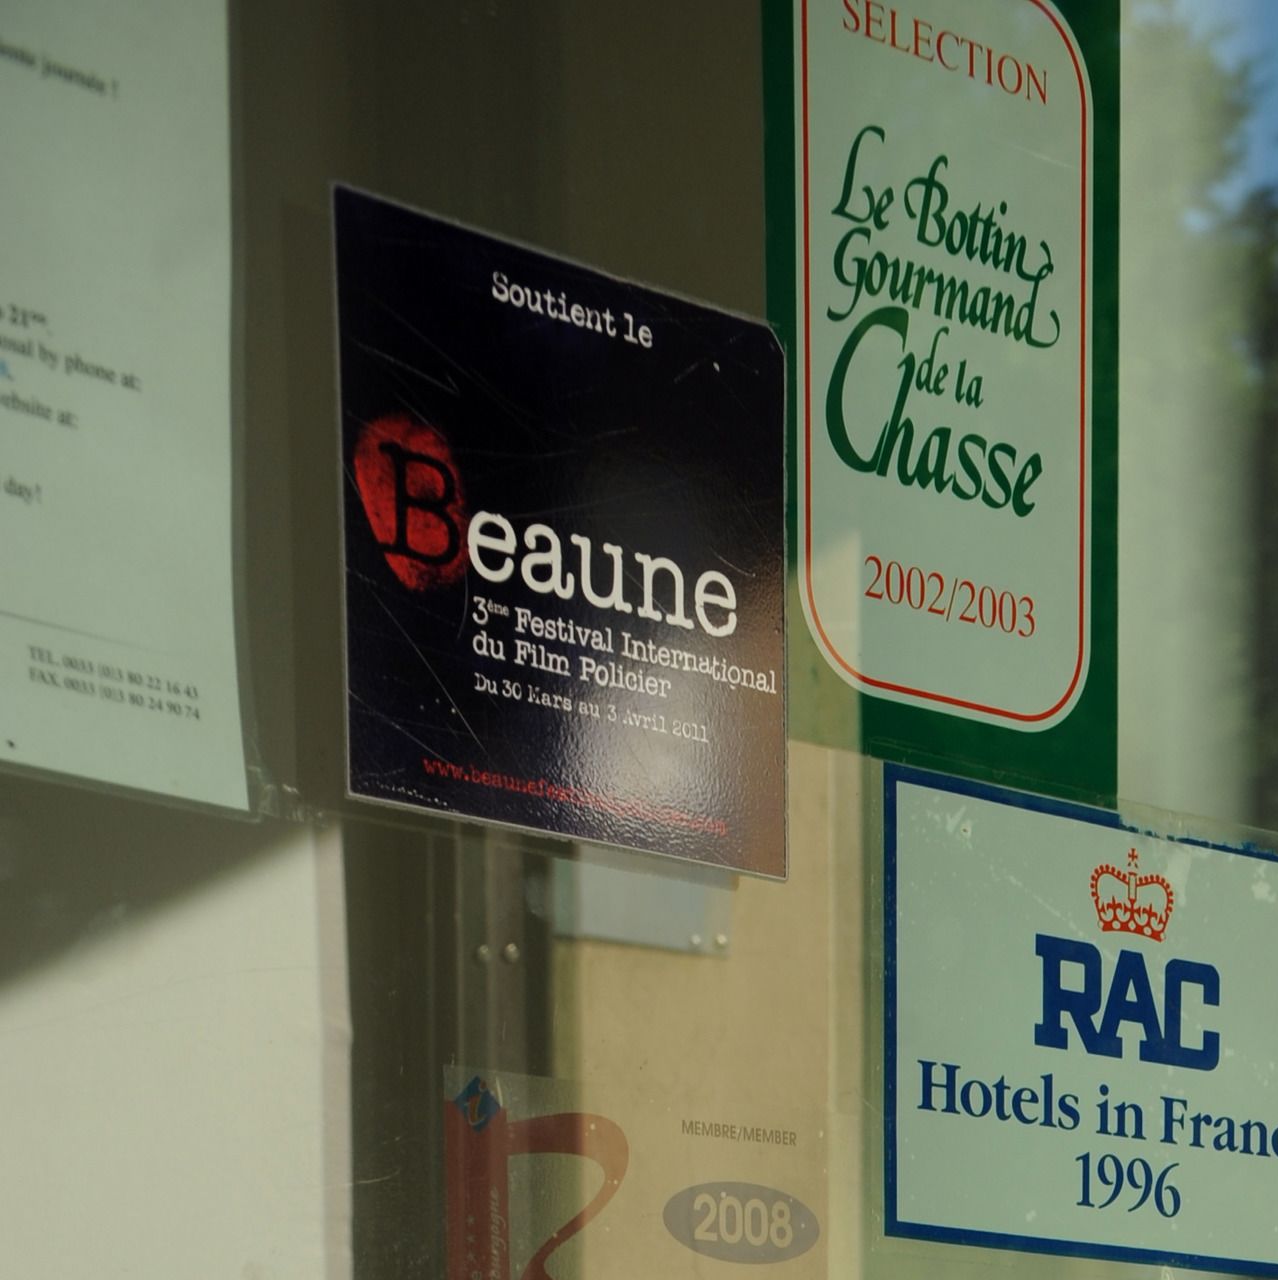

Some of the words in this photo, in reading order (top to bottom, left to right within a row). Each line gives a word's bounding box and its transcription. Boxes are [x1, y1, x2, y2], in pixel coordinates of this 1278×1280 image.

[842, 0, 1047, 105] SELECTION
[831, 125, 894, 231] Le
[903, 155, 1054, 282] Bottin
[491, 270, 618, 336] Soutient
[622, 312, 653, 348] le
[826, 227, 1060, 349] Gourmand
[914, 326, 949, 396] de
[955, 359, 985, 409] la
[825, 306, 1043, 518] Chasse
[376, 440, 738, 637] Beaune
[863, 554, 1036, 638] 2002/2003
[472, 631, 506, 661] du
[514, 639, 571, 677] Film
[579, 656, 672, 698] Policier
[514, 605, 615, 653] Festival
[620, 631, 778, 695] International
[502, 678, 522, 700] 30
[672, 719, 709, 743] 2011
[1034, 932, 1220, 1072] RAC
[682, 1119, 798, 1147] MEMBRE/MEMBER
[917, 1059, 1081, 1131] Hotels
[1096, 1084, 1147, 1141] in
[693, 1192, 794, 1249] 2008
[1075, 1151, 1181, 1218] 1996
